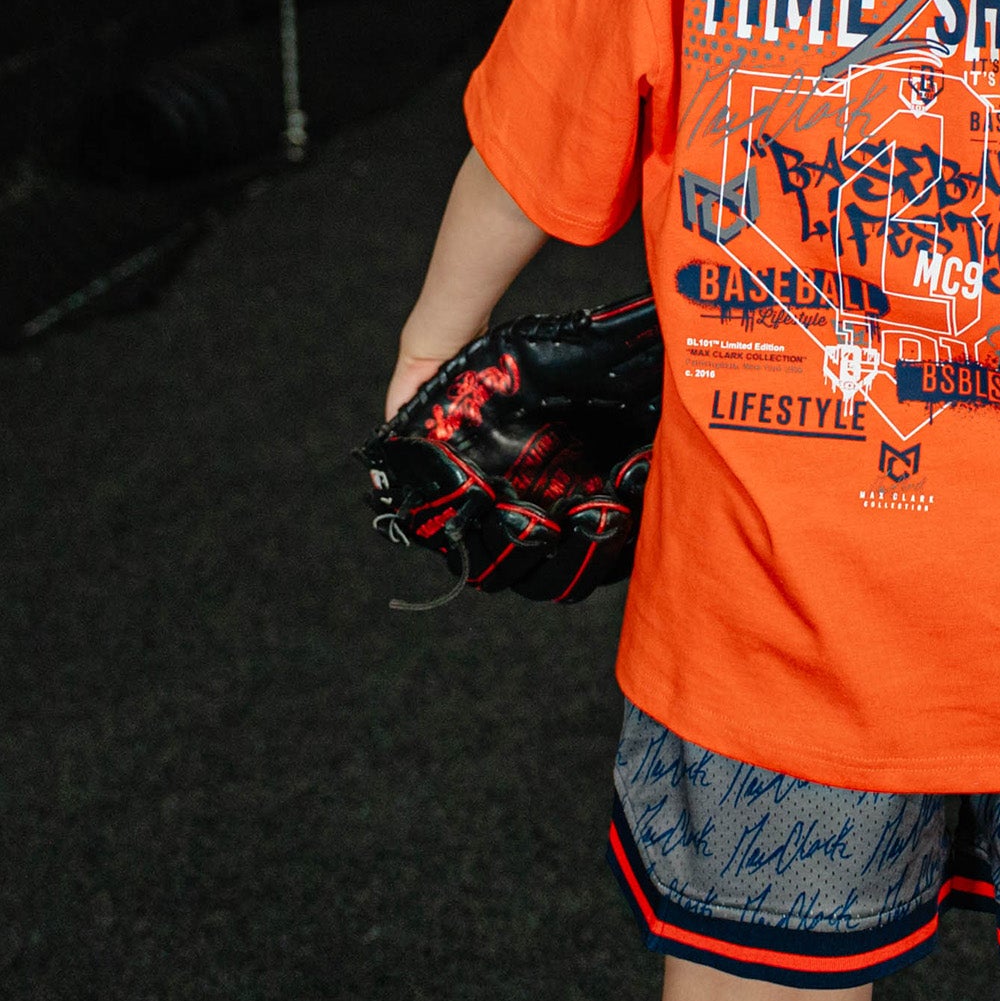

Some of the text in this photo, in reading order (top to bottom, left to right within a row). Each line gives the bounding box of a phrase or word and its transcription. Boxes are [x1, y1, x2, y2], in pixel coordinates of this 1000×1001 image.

[700, 263, 881, 315] BASEBALL
[913, 250, 984, 300] MC9
[756, 306, 828, 331] Lifestyle
[712, 350, 743, 360] CLARK
[720, 340, 752, 351] Limited
[754, 342, 785, 353] Edition
[711, 389, 867, 431] LIFESTYLE
